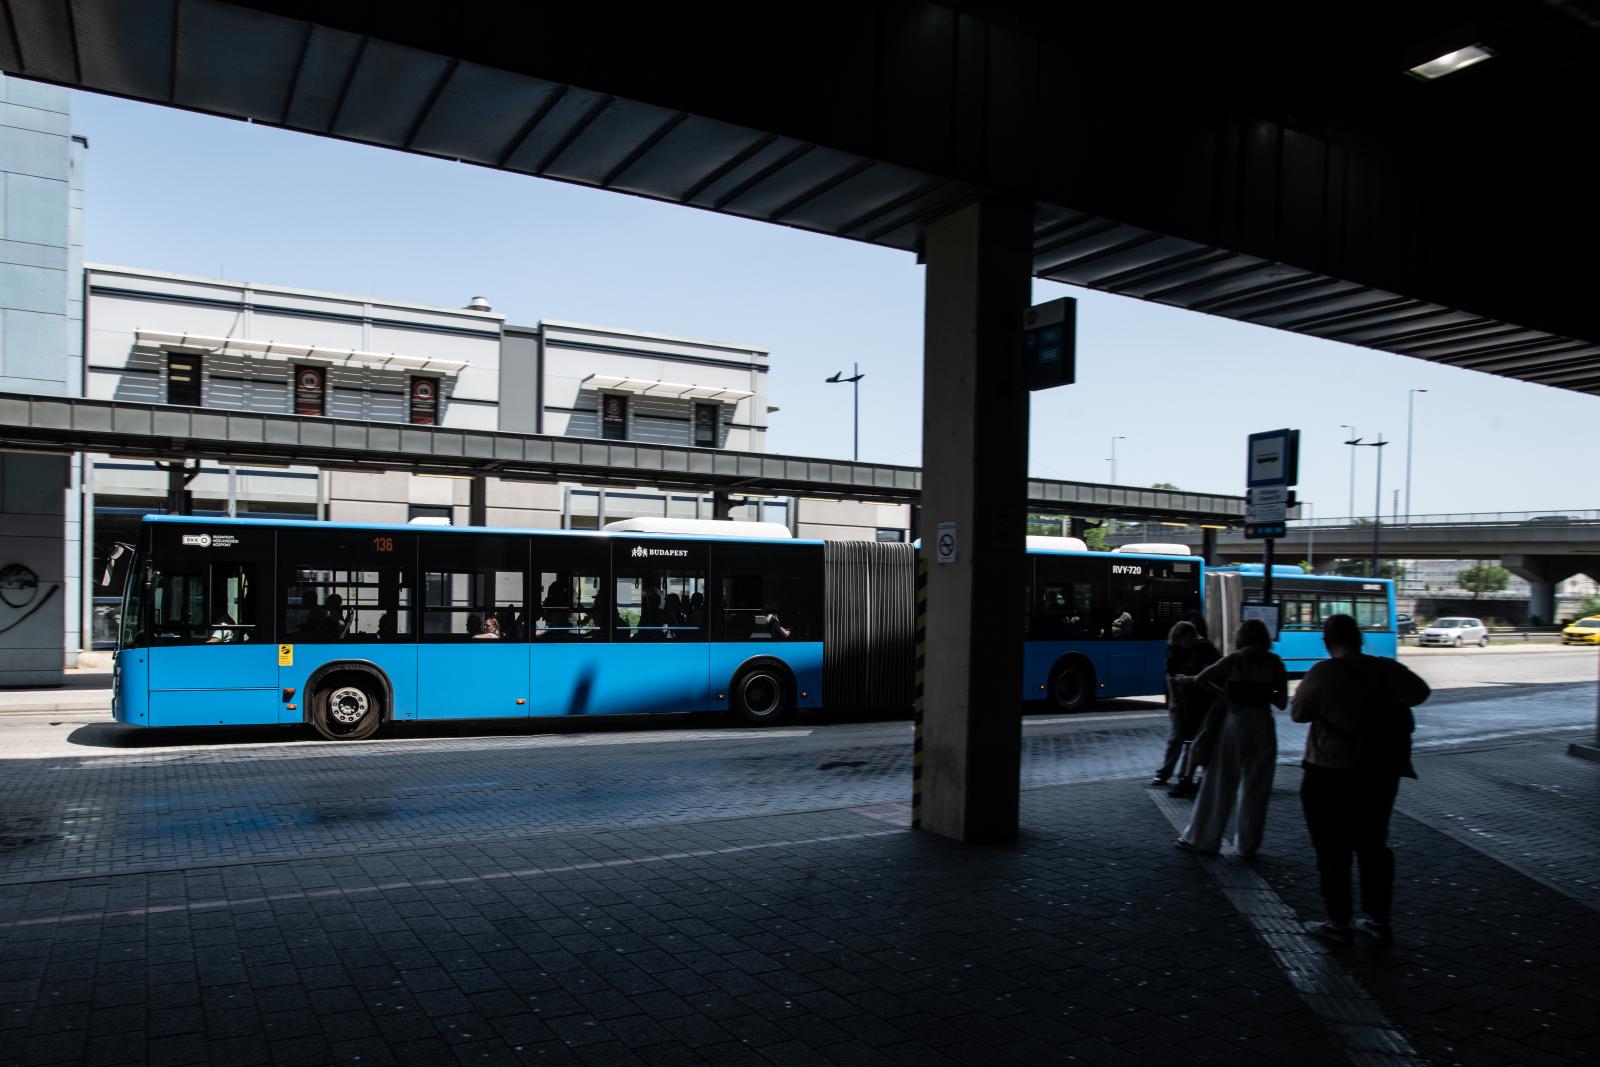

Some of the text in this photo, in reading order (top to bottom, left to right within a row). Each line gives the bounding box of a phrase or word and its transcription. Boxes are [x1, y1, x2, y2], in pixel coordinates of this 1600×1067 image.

[374, 538, 393, 552] 136
[649, 548, 688, 557] BUDAPEST
[1112, 566, 1142, 575] RVY-720
